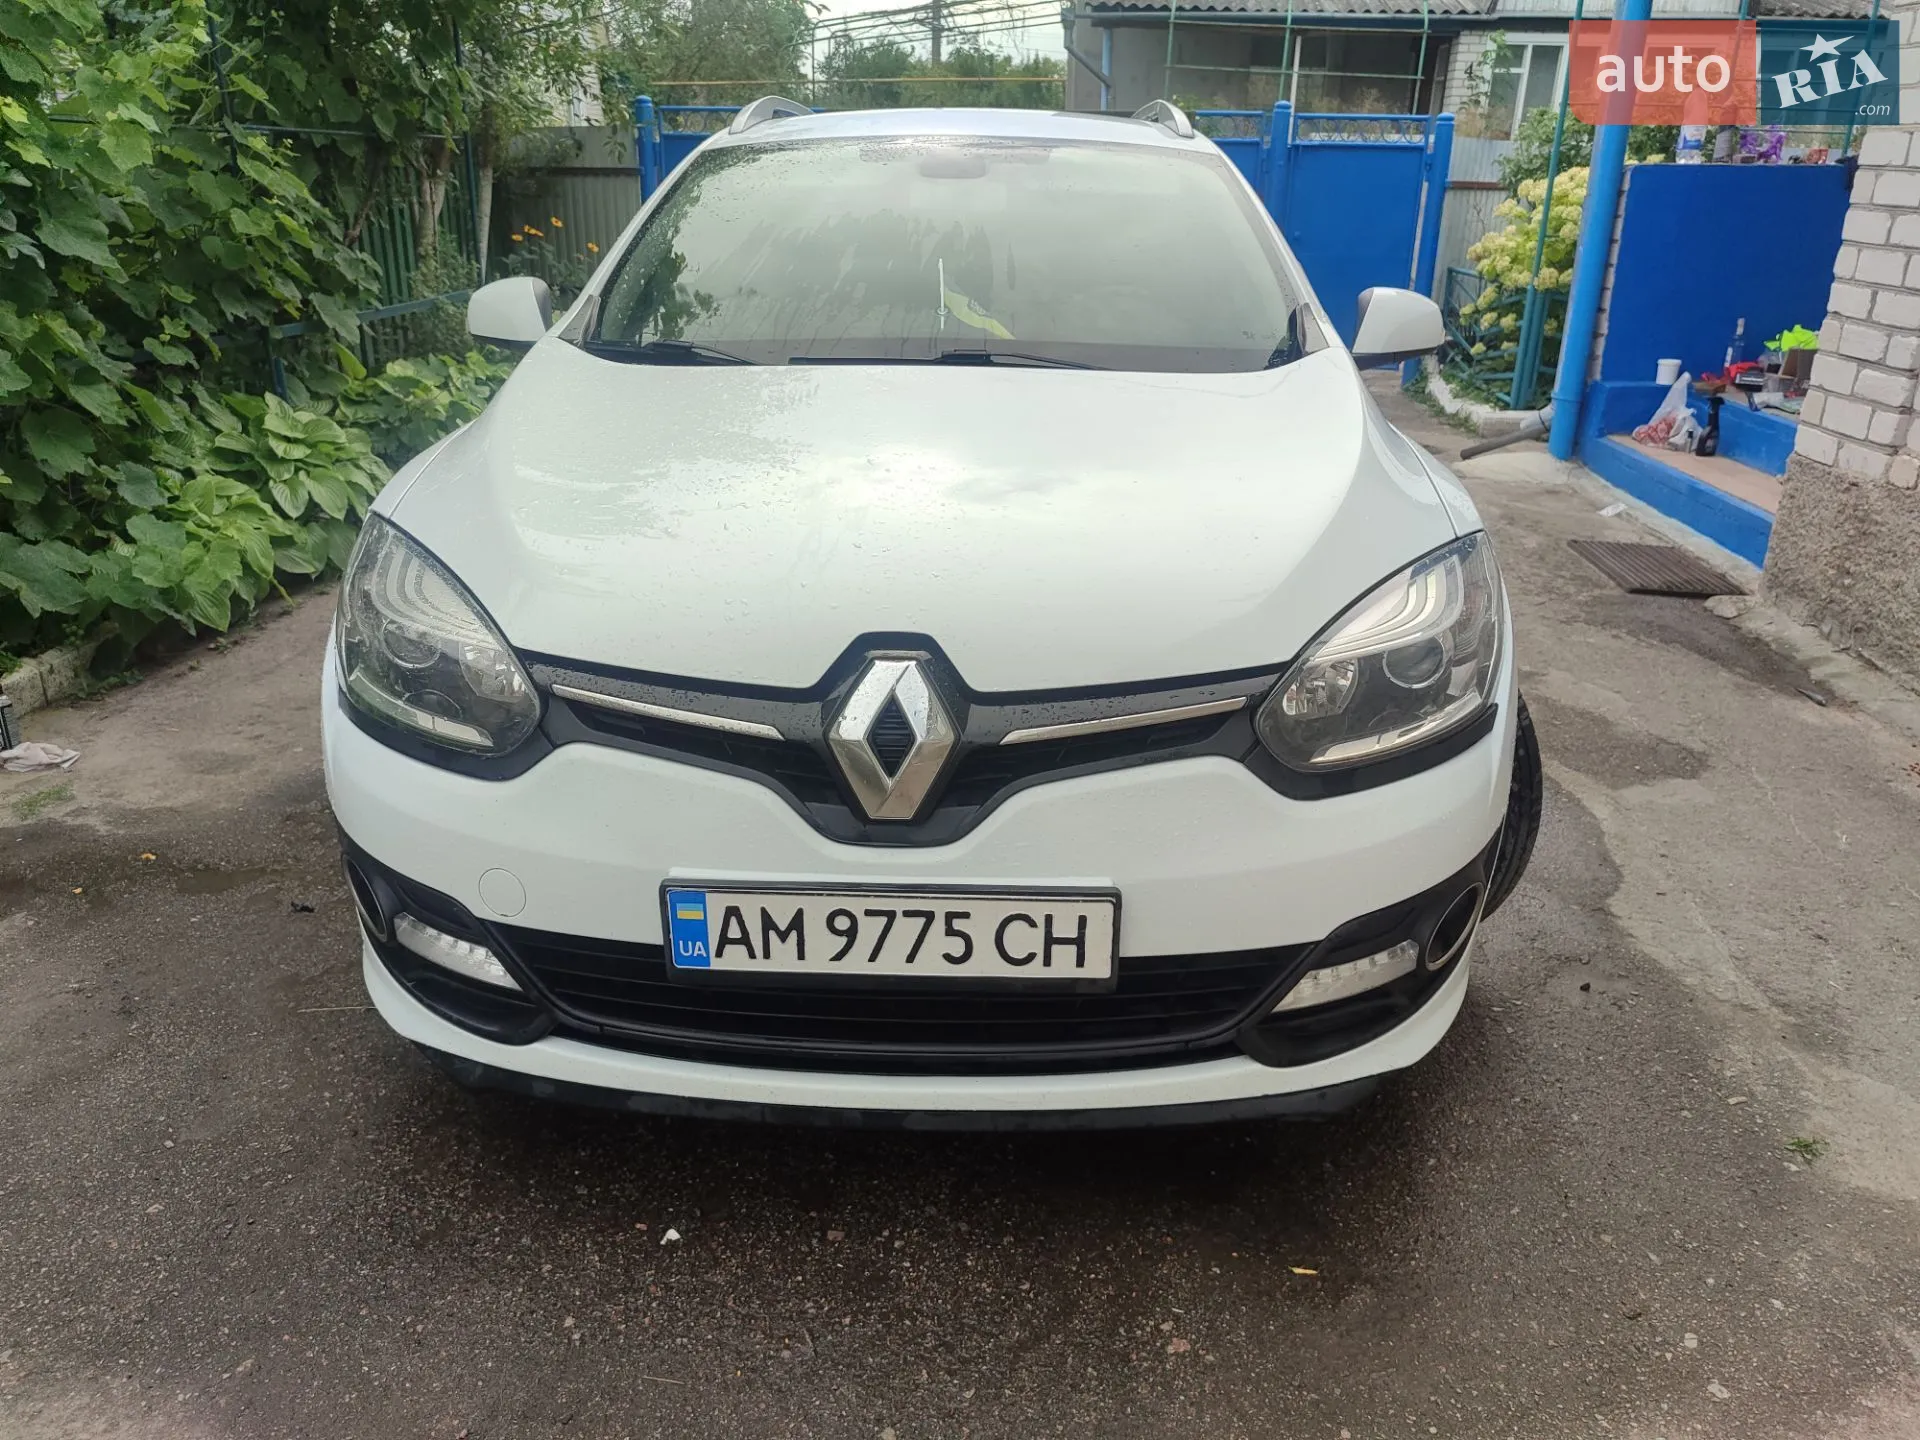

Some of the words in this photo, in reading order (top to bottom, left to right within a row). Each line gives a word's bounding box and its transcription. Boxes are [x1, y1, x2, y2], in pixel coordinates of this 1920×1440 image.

[680, 940, 707, 957] UA
[714, 905, 806, 961] AM
[826, 908, 974, 965] 9775
[994, 912, 1087, 968] CH
